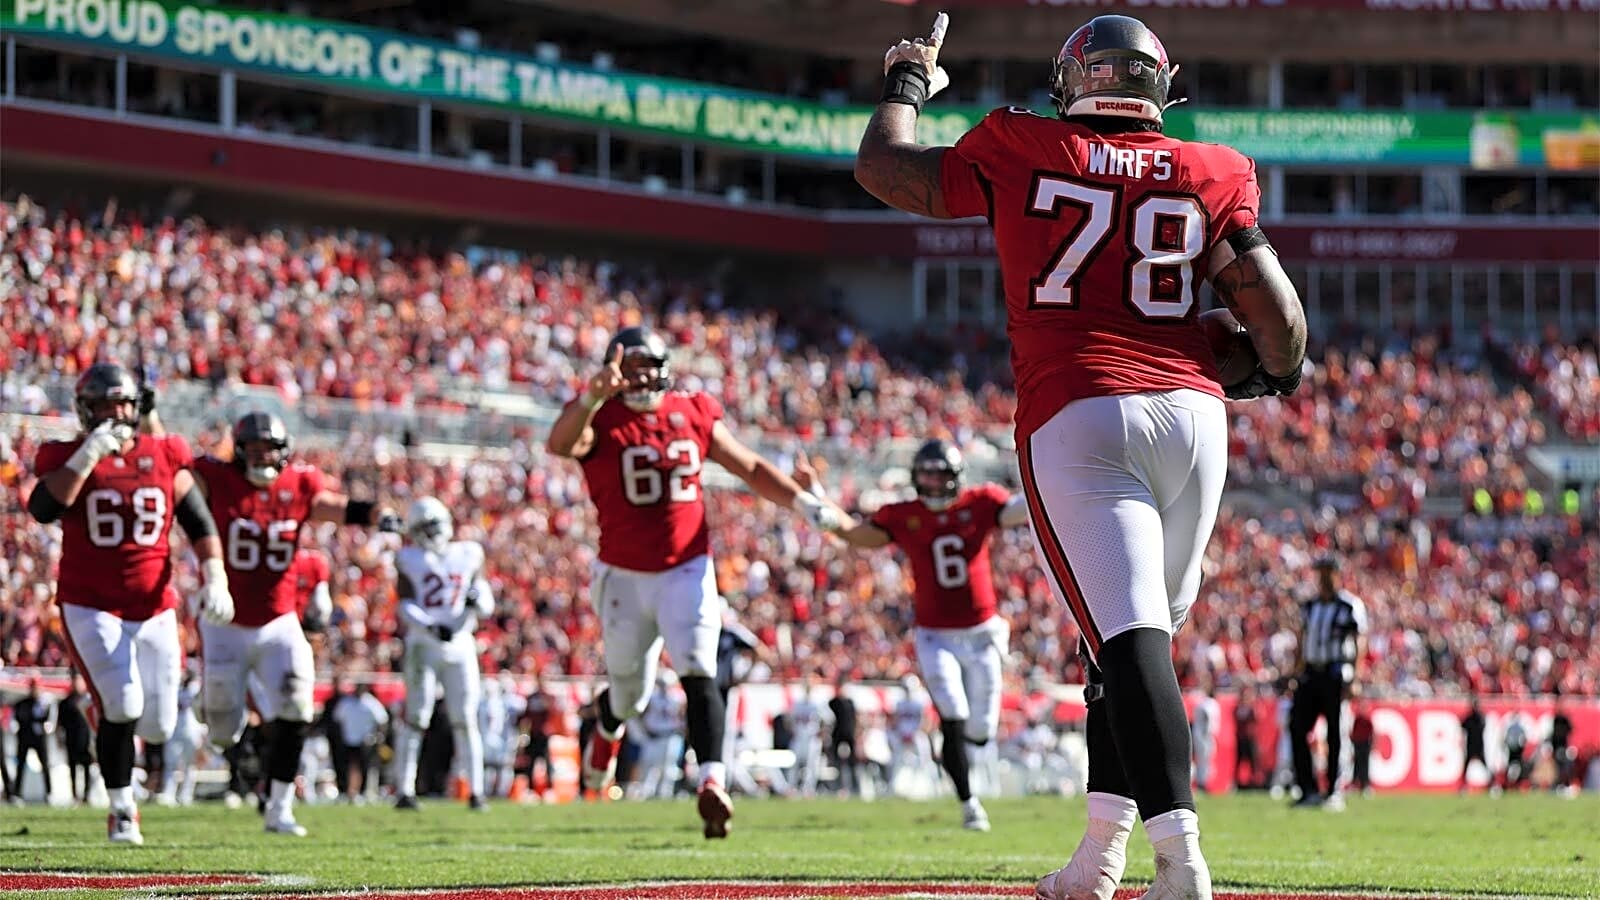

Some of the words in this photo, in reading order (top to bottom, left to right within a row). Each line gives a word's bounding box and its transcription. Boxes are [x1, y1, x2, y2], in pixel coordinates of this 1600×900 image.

[175, 5, 373, 80] SPONSOR
[378, 40, 432, 86] OF
[438, 50, 512, 102] THE
[515, 61, 634, 123] TAMPA
[635, 83, 703, 133] BAY
[1095, 101, 1144, 113] BUCCANEERS
[1088, 142, 1173, 181] WIRFS
[1029, 174, 1207, 320] 78
[620, 438, 700, 506] 62
[86, 486, 167, 548] 68
[227, 517, 298, 572] 65
[932, 533, 968, 588] 6
[421, 572, 465, 608] 27
